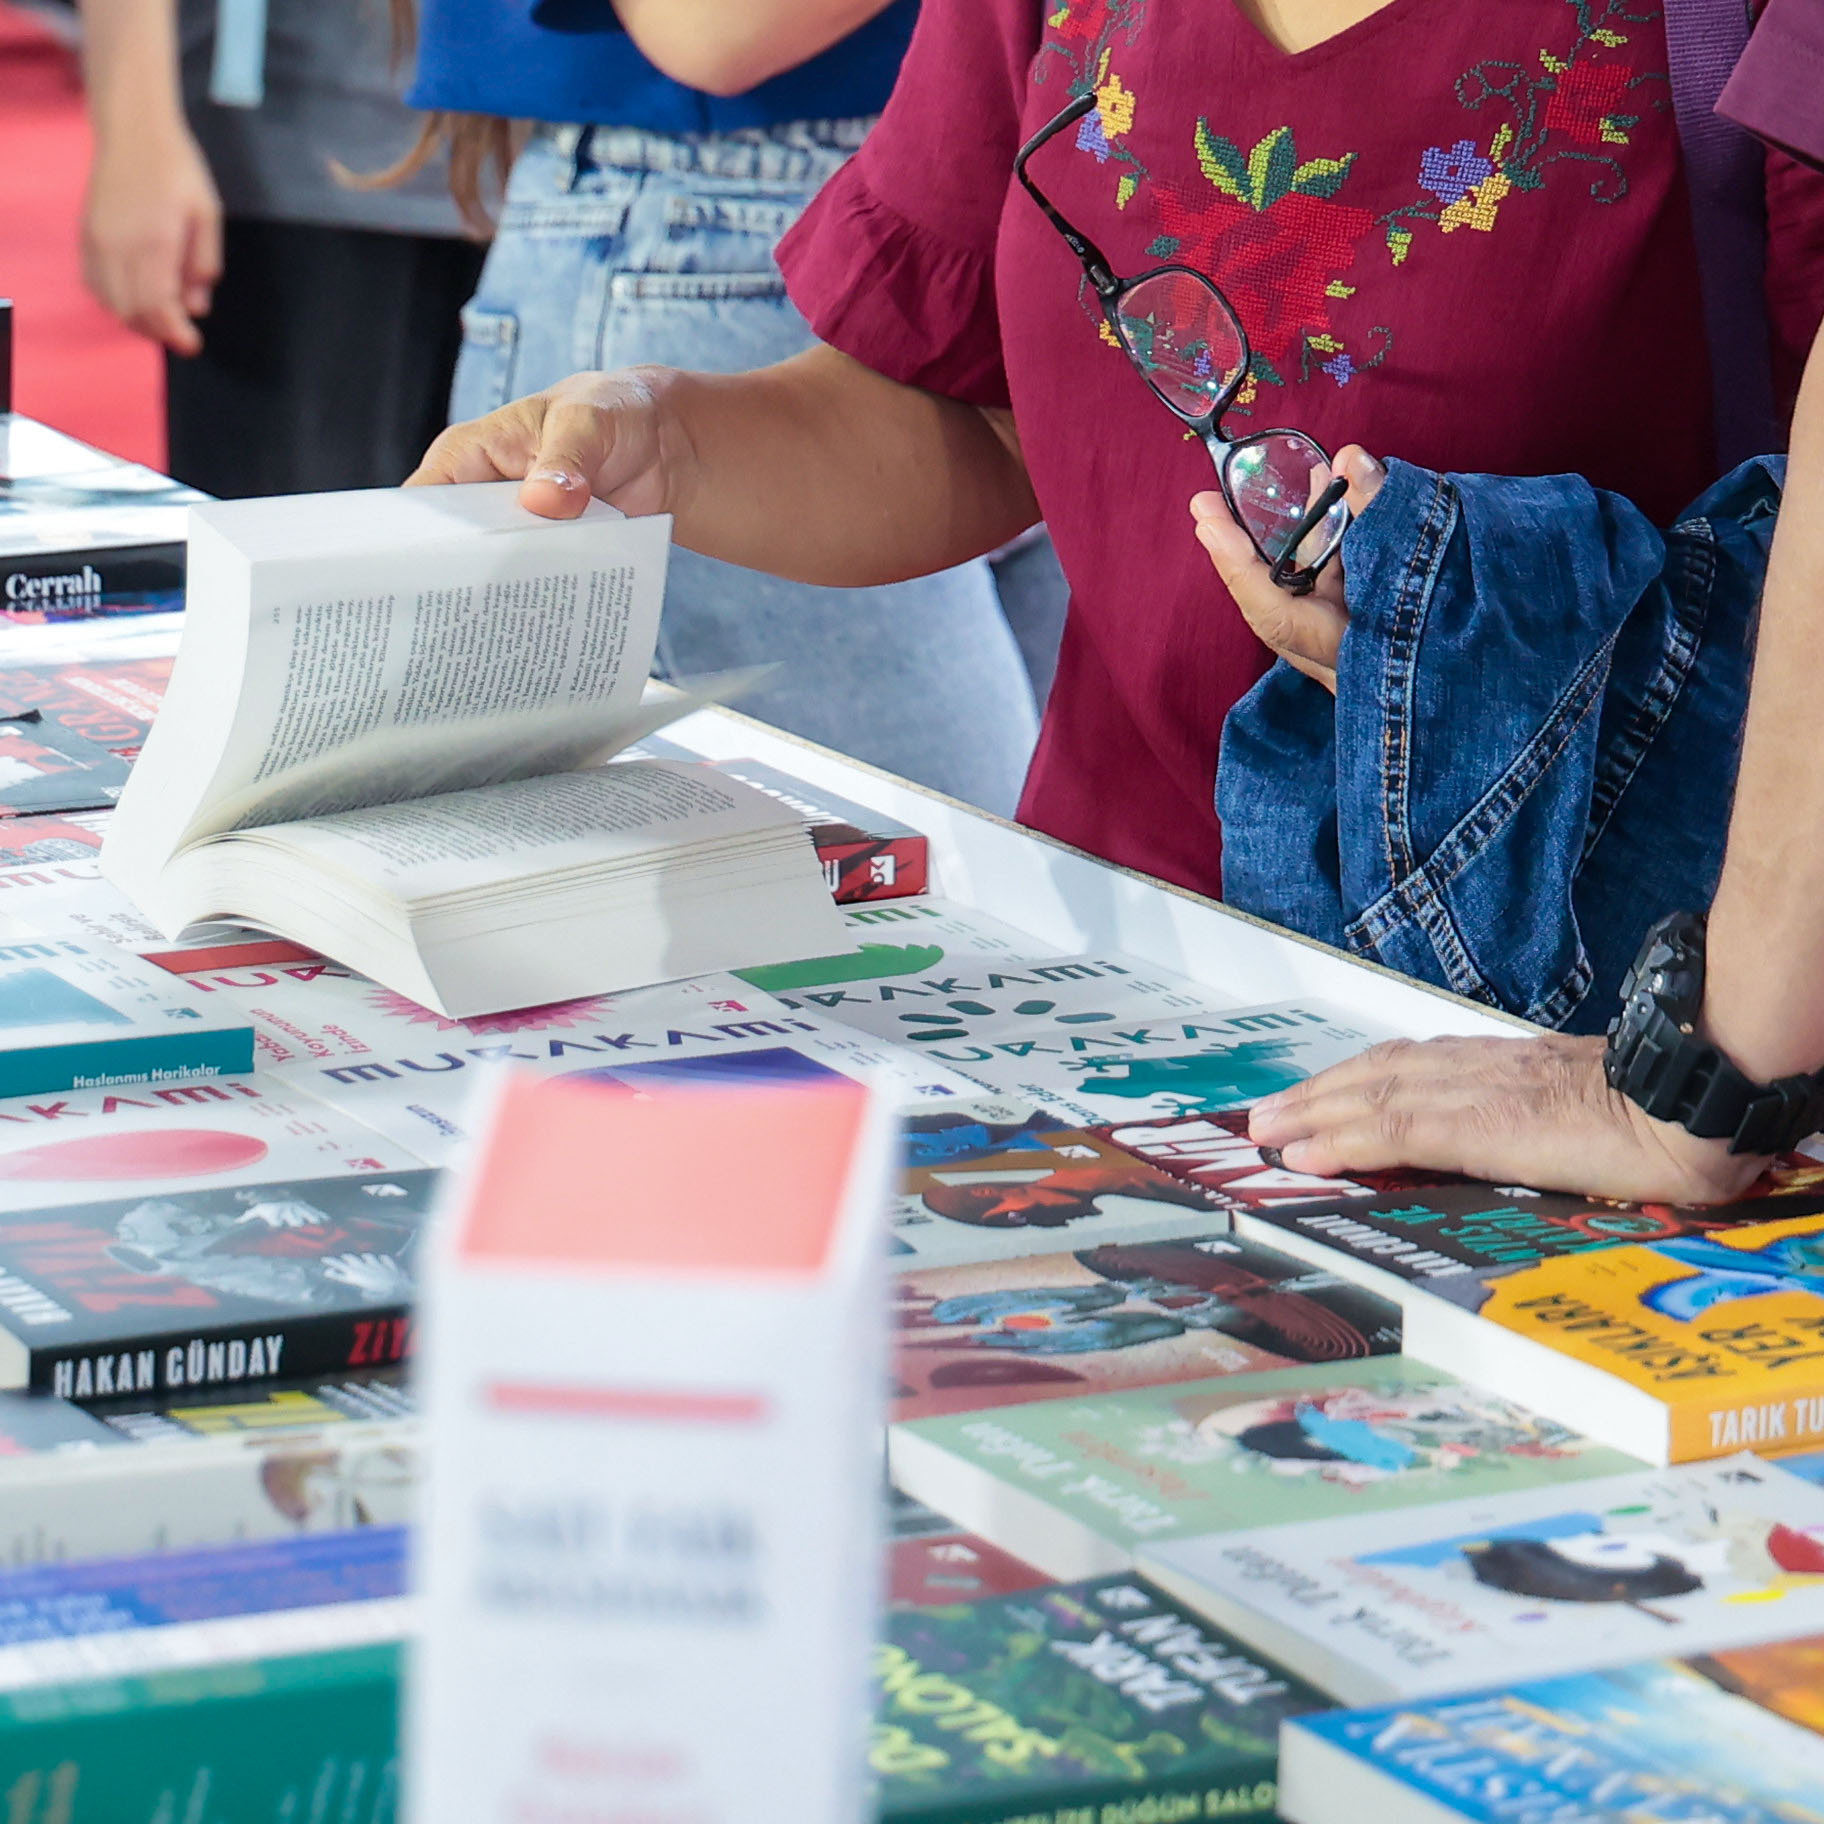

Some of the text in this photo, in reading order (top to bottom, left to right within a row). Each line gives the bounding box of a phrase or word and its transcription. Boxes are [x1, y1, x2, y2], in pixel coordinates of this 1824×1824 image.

[5, 565, 103, 601] Cerrah
[151, 1061, 223, 1083] Harikalar
[54, 1348, 156, 1400] HAKAN
[166, 1333, 286, 1389] GÜNDAY
[1709, 1403, 1787, 1447] TARIK
[1049, 1629, 1205, 1712] TARIK
[1118, 1613, 1289, 1706] TUFAN
